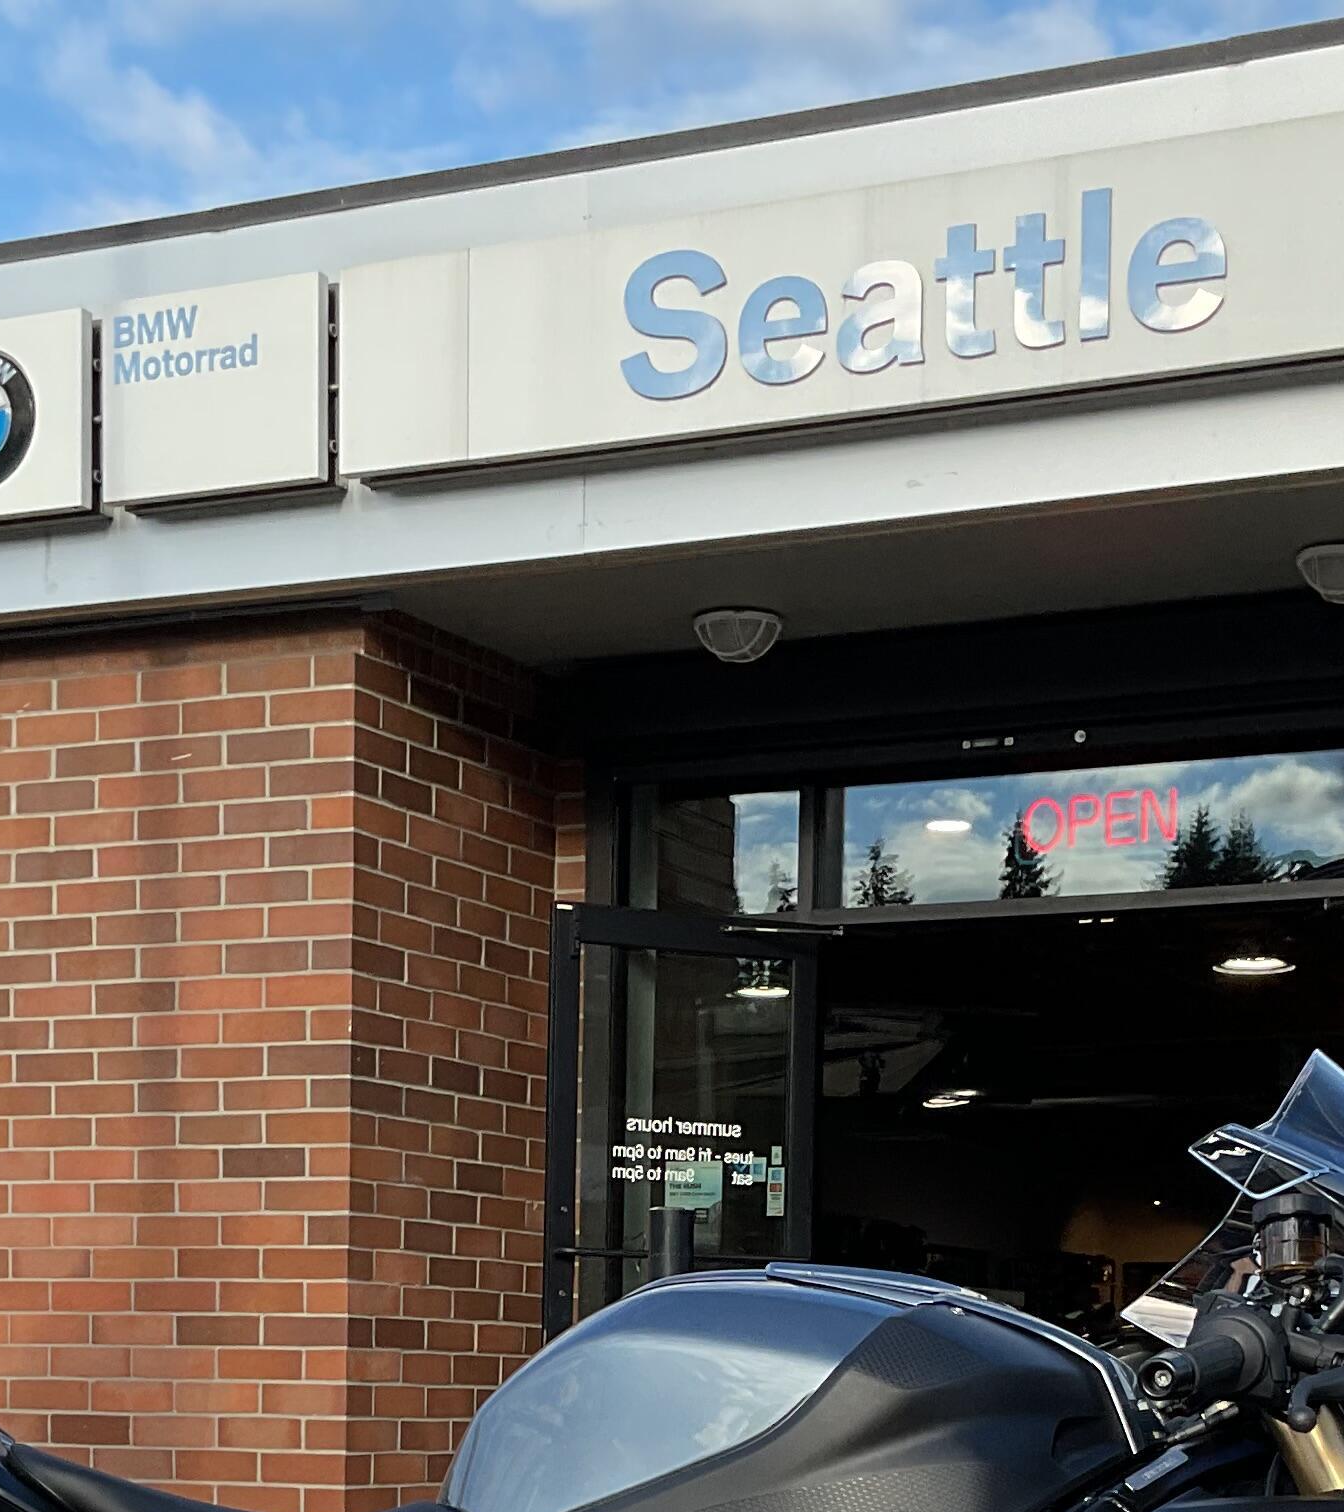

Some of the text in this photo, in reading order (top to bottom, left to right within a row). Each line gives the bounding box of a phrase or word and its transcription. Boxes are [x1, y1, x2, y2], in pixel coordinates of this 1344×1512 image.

[619, 187, 1228, 400] Seattle
[112, 305, 198, 348] BMW
[113, 334, 258, 385] Motorrad
[1022, 786, 1179, 853] OPEN
